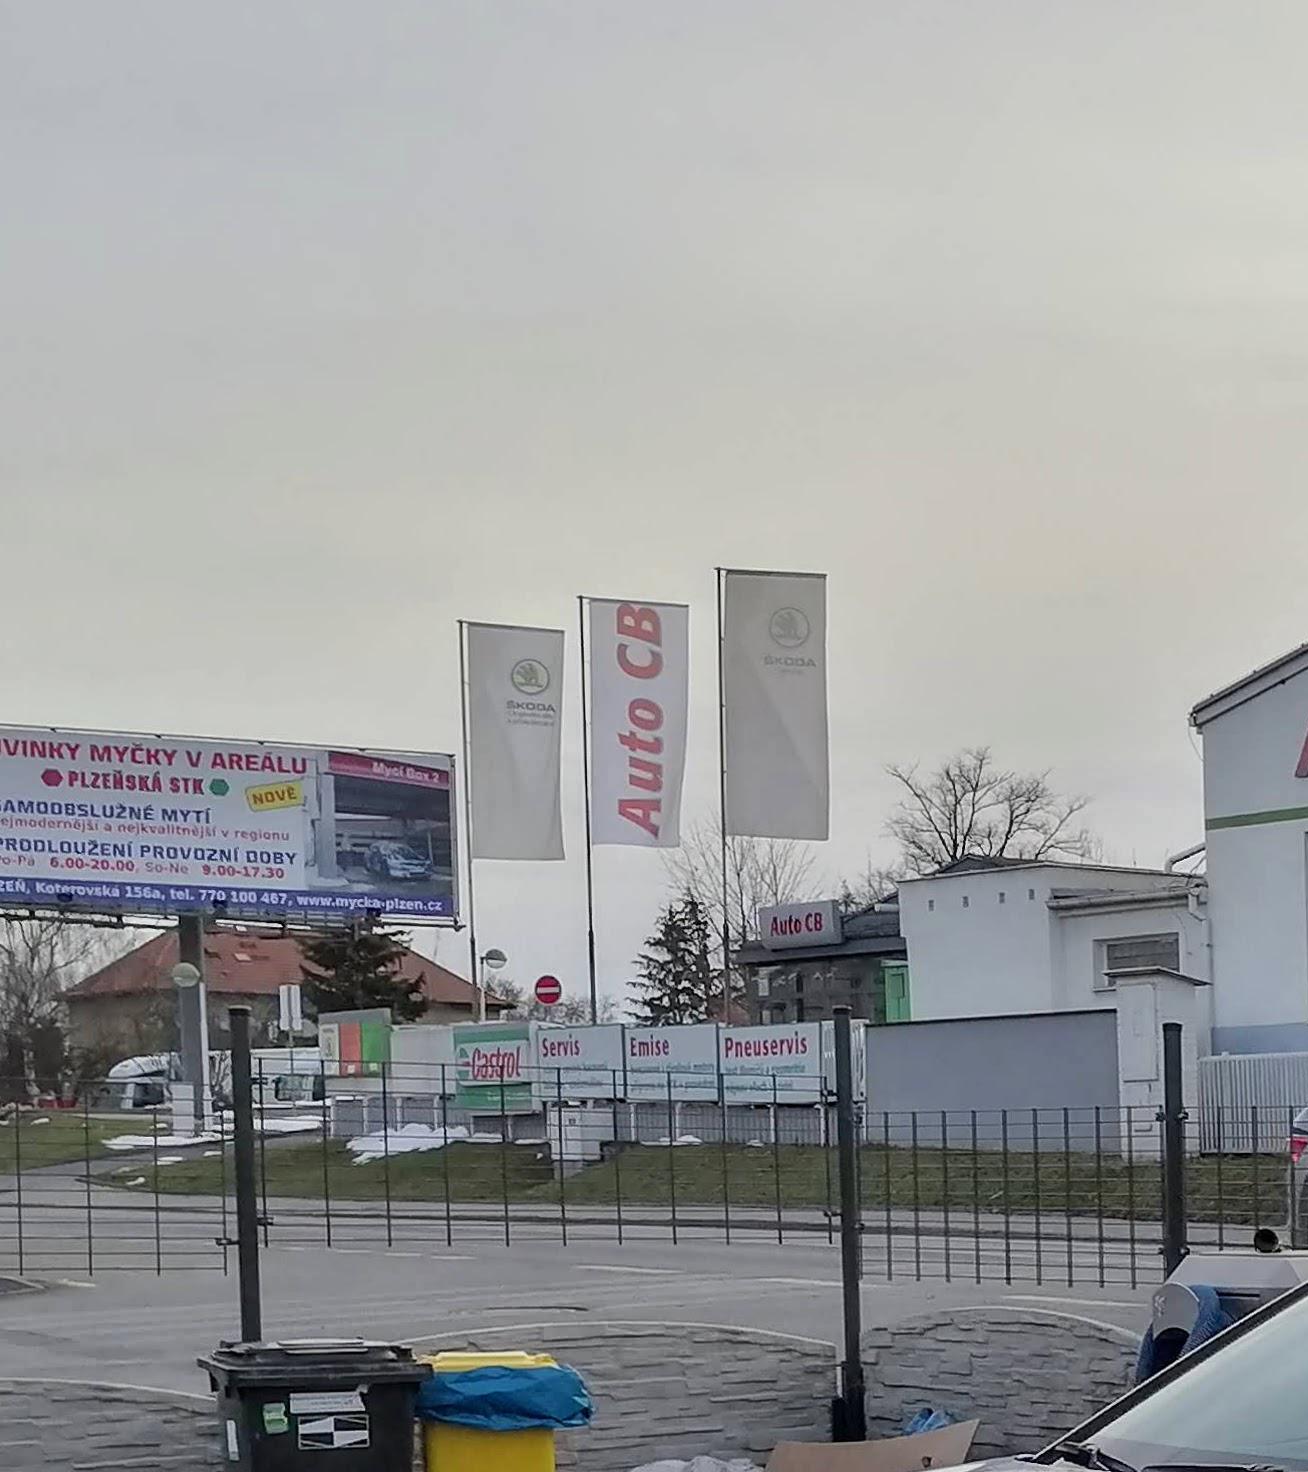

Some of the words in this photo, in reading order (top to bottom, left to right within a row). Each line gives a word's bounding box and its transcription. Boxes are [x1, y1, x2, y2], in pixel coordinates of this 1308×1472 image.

[617, 603, 663, 679] CB
[0, 737, 80, 761] VINKY
[90, 742, 177, 766] MYČKY
[187, 750, 202, 768] V
[211, 752, 307, 775] AREÁLU
[618, 698, 663, 839] Auto
[68, 769, 162, 793] PLZEŇSKÁ
[170, 777, 205, 795] STK
[0, 799, 155, 821] AMOOBSLUŽNÉ
[162, 807, 211, 824] MYTÍ
[104, 822, 112, 832] a
[0, 837, 133, 857] RODLOUŽENÍ
[140, 845, 239, 863] PROVOZNÍ
[246, 851, 298, 867] DOBY
[0, 855, 35, 867] o-Pá
[770, 917, 801, 937] Auto
[805, 913, 823, 932] CB
[542, 1034, 580, 1058] Servis
[630, 1034, 670, 1057] Emise
[725, 1031, 808, 1058] Pneuservis
[472, 1046, 521, 1080] Castrol
